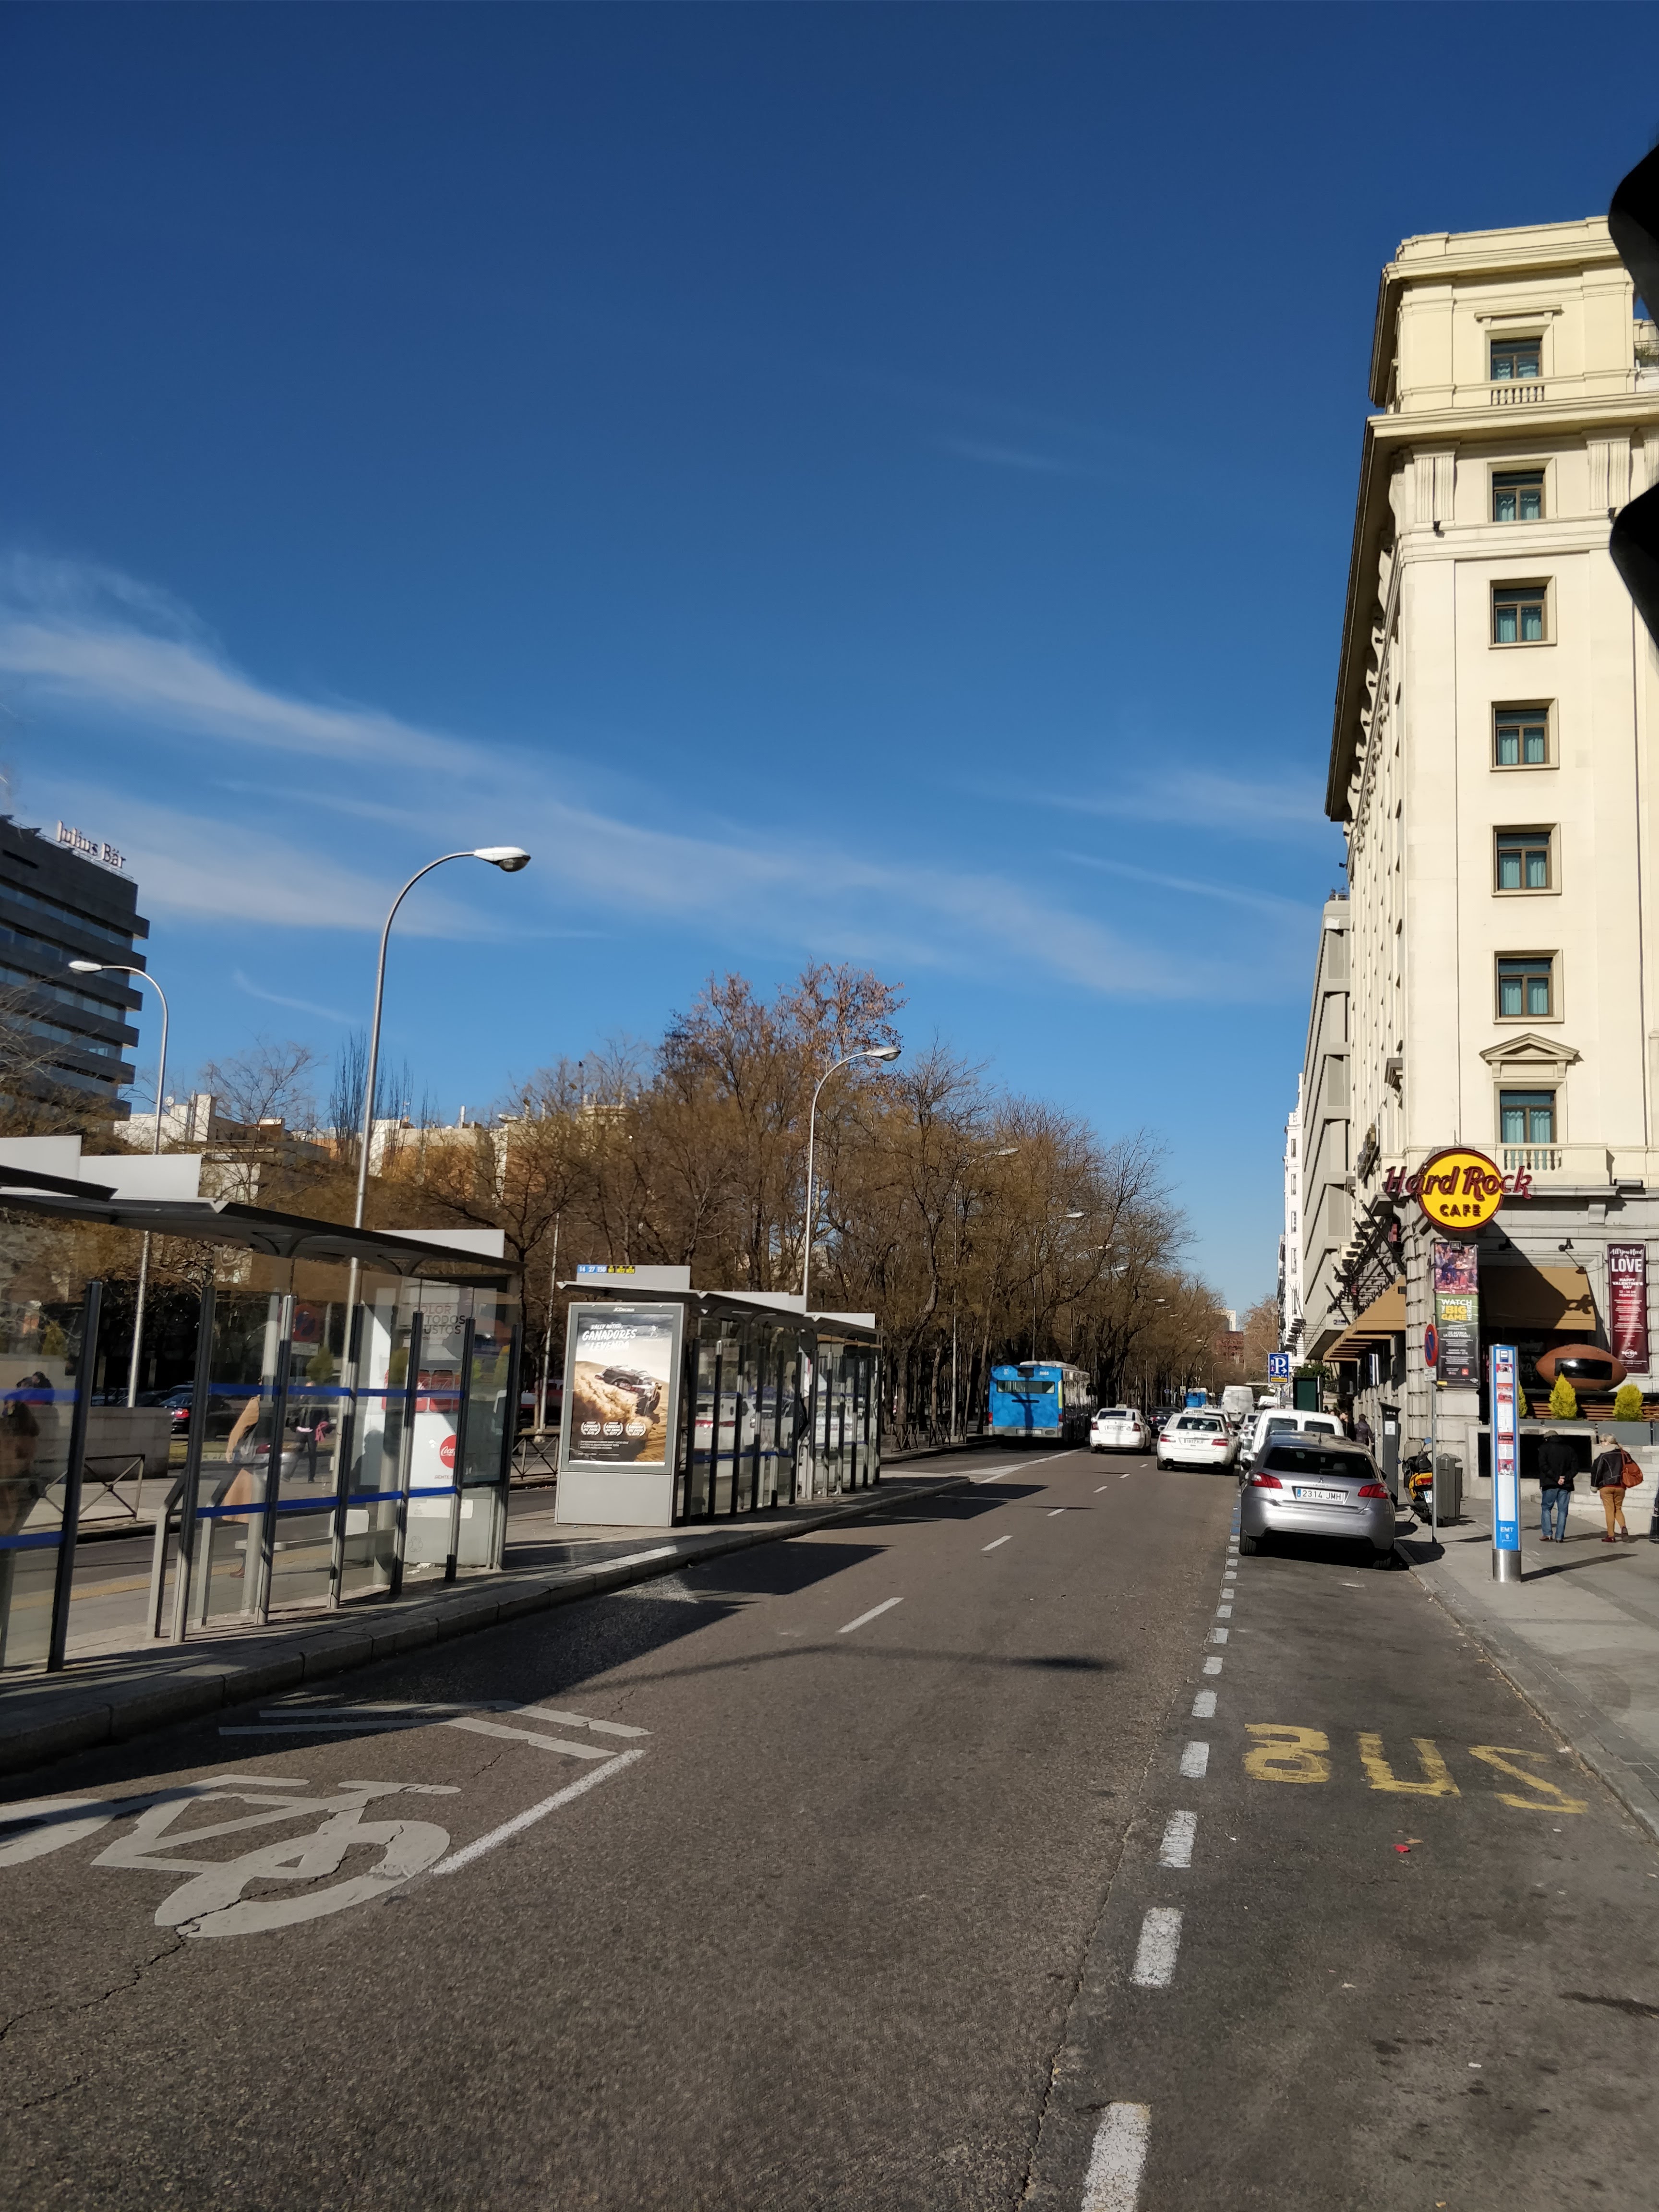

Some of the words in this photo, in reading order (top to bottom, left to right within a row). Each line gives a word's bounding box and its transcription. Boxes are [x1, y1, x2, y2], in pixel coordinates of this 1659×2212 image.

[57, 820, 98, 856] Julius
[101, 842, 126, 869] Bär
[1383, 1166, 1460, 1196] Hard
[1462, 1166, 1533, 1202] Rock
[1440, 1204, 1480, 1217] CAFE
[1611, 1258, 1643, 1272] LOVE
[1445, 1305, 1467, 1314] BIG
[426, 1315, 465, 1324] TODOS
[424, 1325, 461, 1334] USTOS
[582, 1329, 637, 1341] GANADORES
[1274, 1357, 1286, 1374] P
[1302, 1490, 1322, 1498] 2314
[1326, 1492, 1341, 1500] JMH
[1242, 1723, 1588, 1814] BUS
